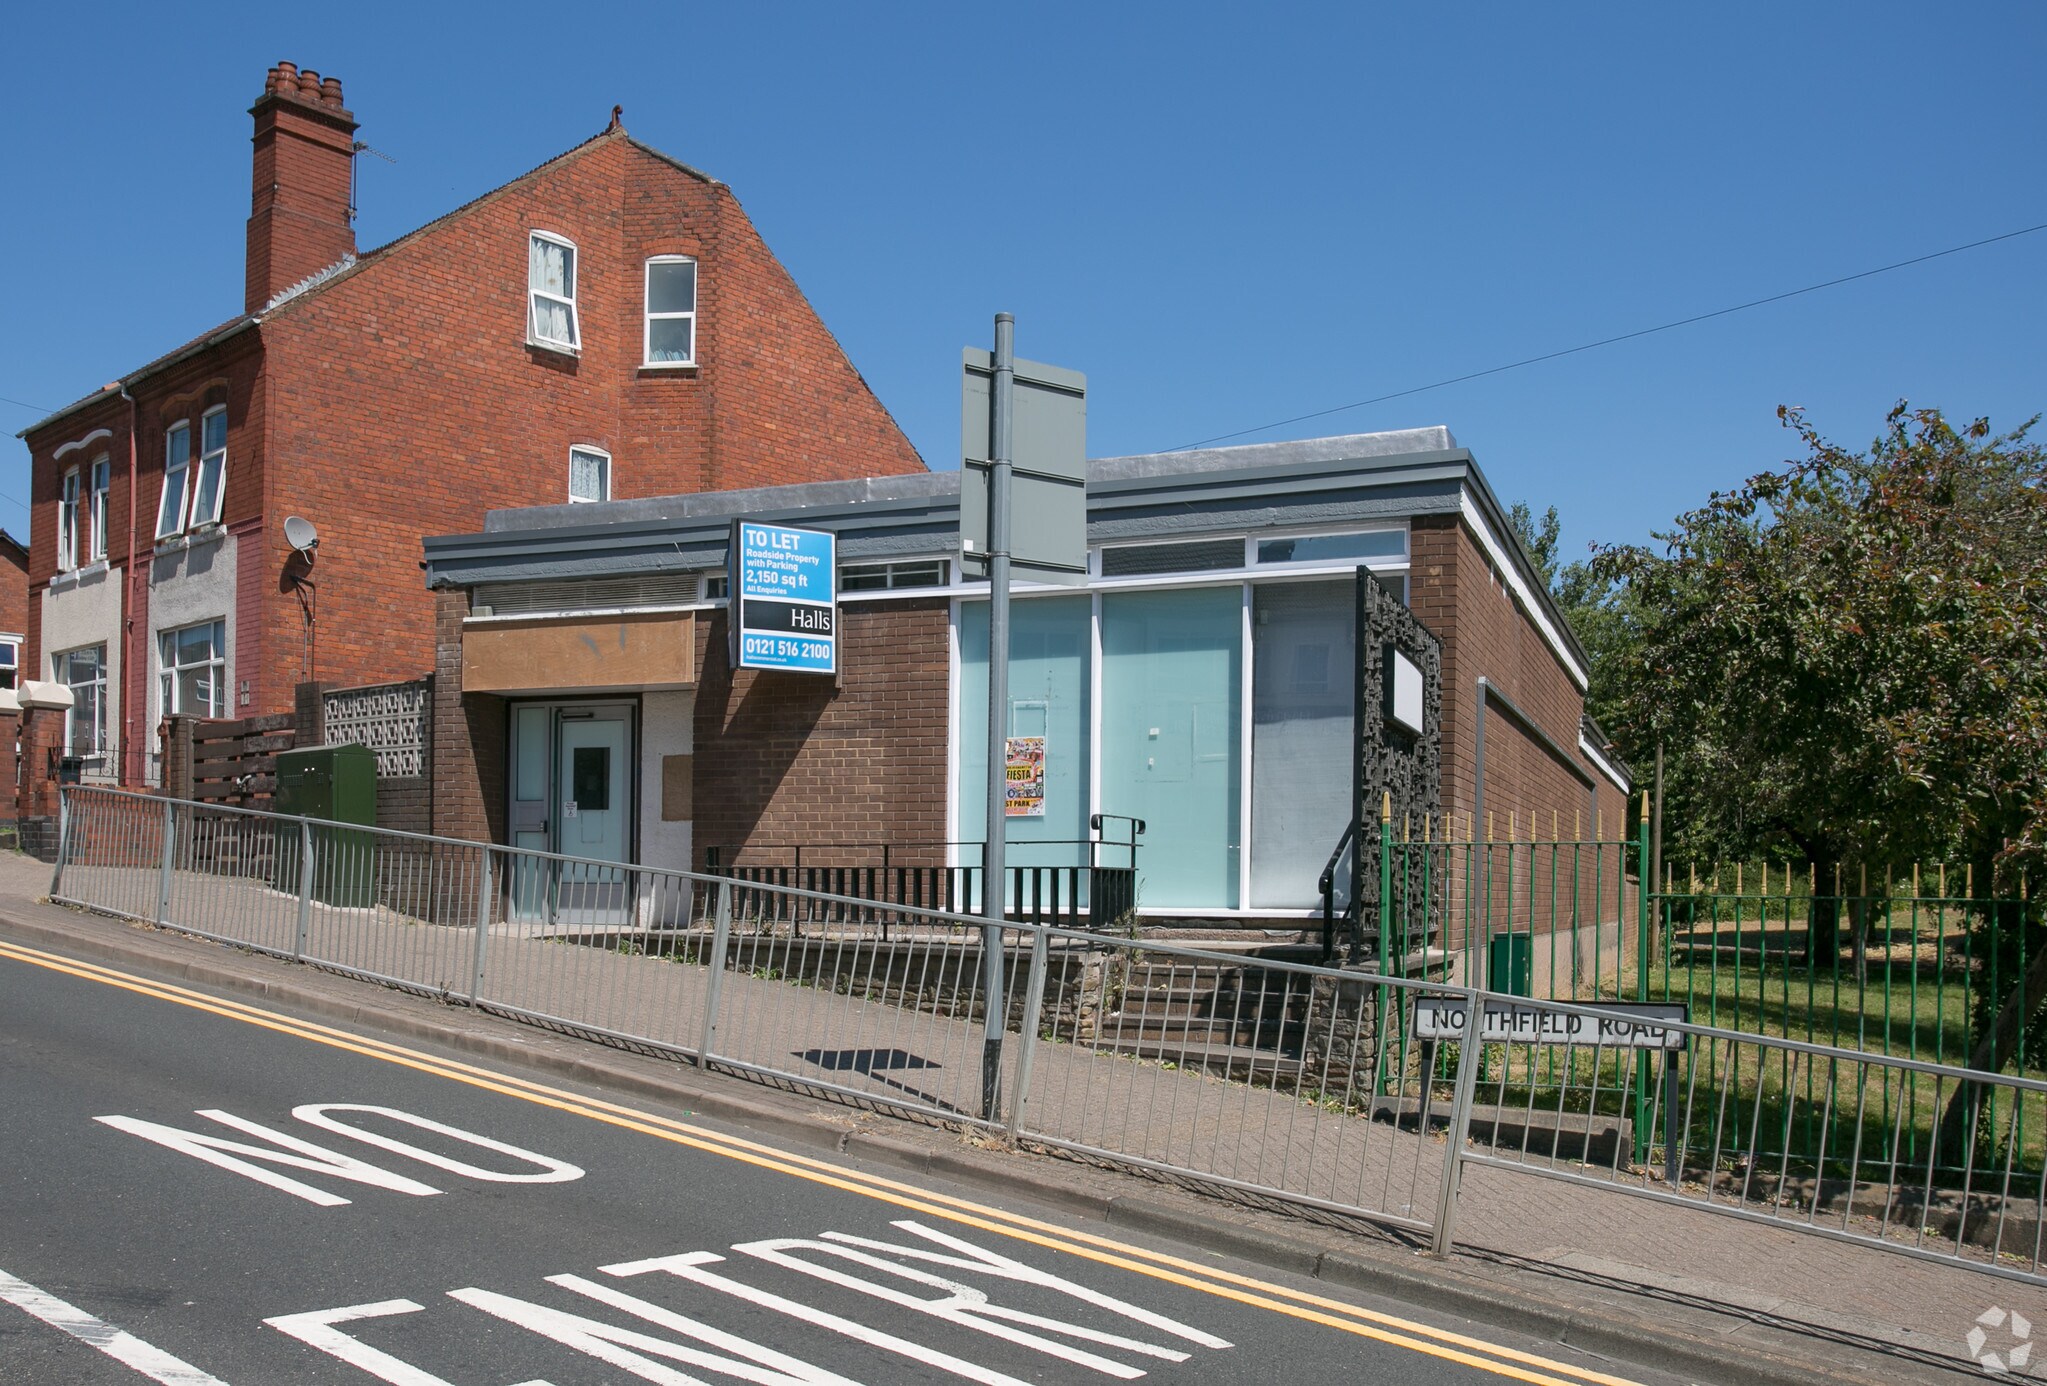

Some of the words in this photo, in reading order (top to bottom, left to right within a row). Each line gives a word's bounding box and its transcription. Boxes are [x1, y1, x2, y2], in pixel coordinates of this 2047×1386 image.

[746, 529, 767, 547] TO
[771, 532, 800, 550] LET
[746, 548, 784, 560] Roadside
[786, 552, 820, 566] Property
[747, 559, 765, 568] with
[766, 560, 799, 573] Parking
[746, 569, 778, 584] 2,150
[781, 575, 796, 588] sq
[798, 574, 808, 587] ft
[757, 585, 787, 595] Enquiries
[791, 608, 830, 630] Halls
[746, 638, 775, 655] 0121
[778, 640, 799, 657] 516
[801, 643, 830, 659] 2100
[1006, 770, 1031, 780] FIESTA
[1432, 1008, 1582, 1034] NOTHFIELD
[91, 1102, 586, 1206] NO
